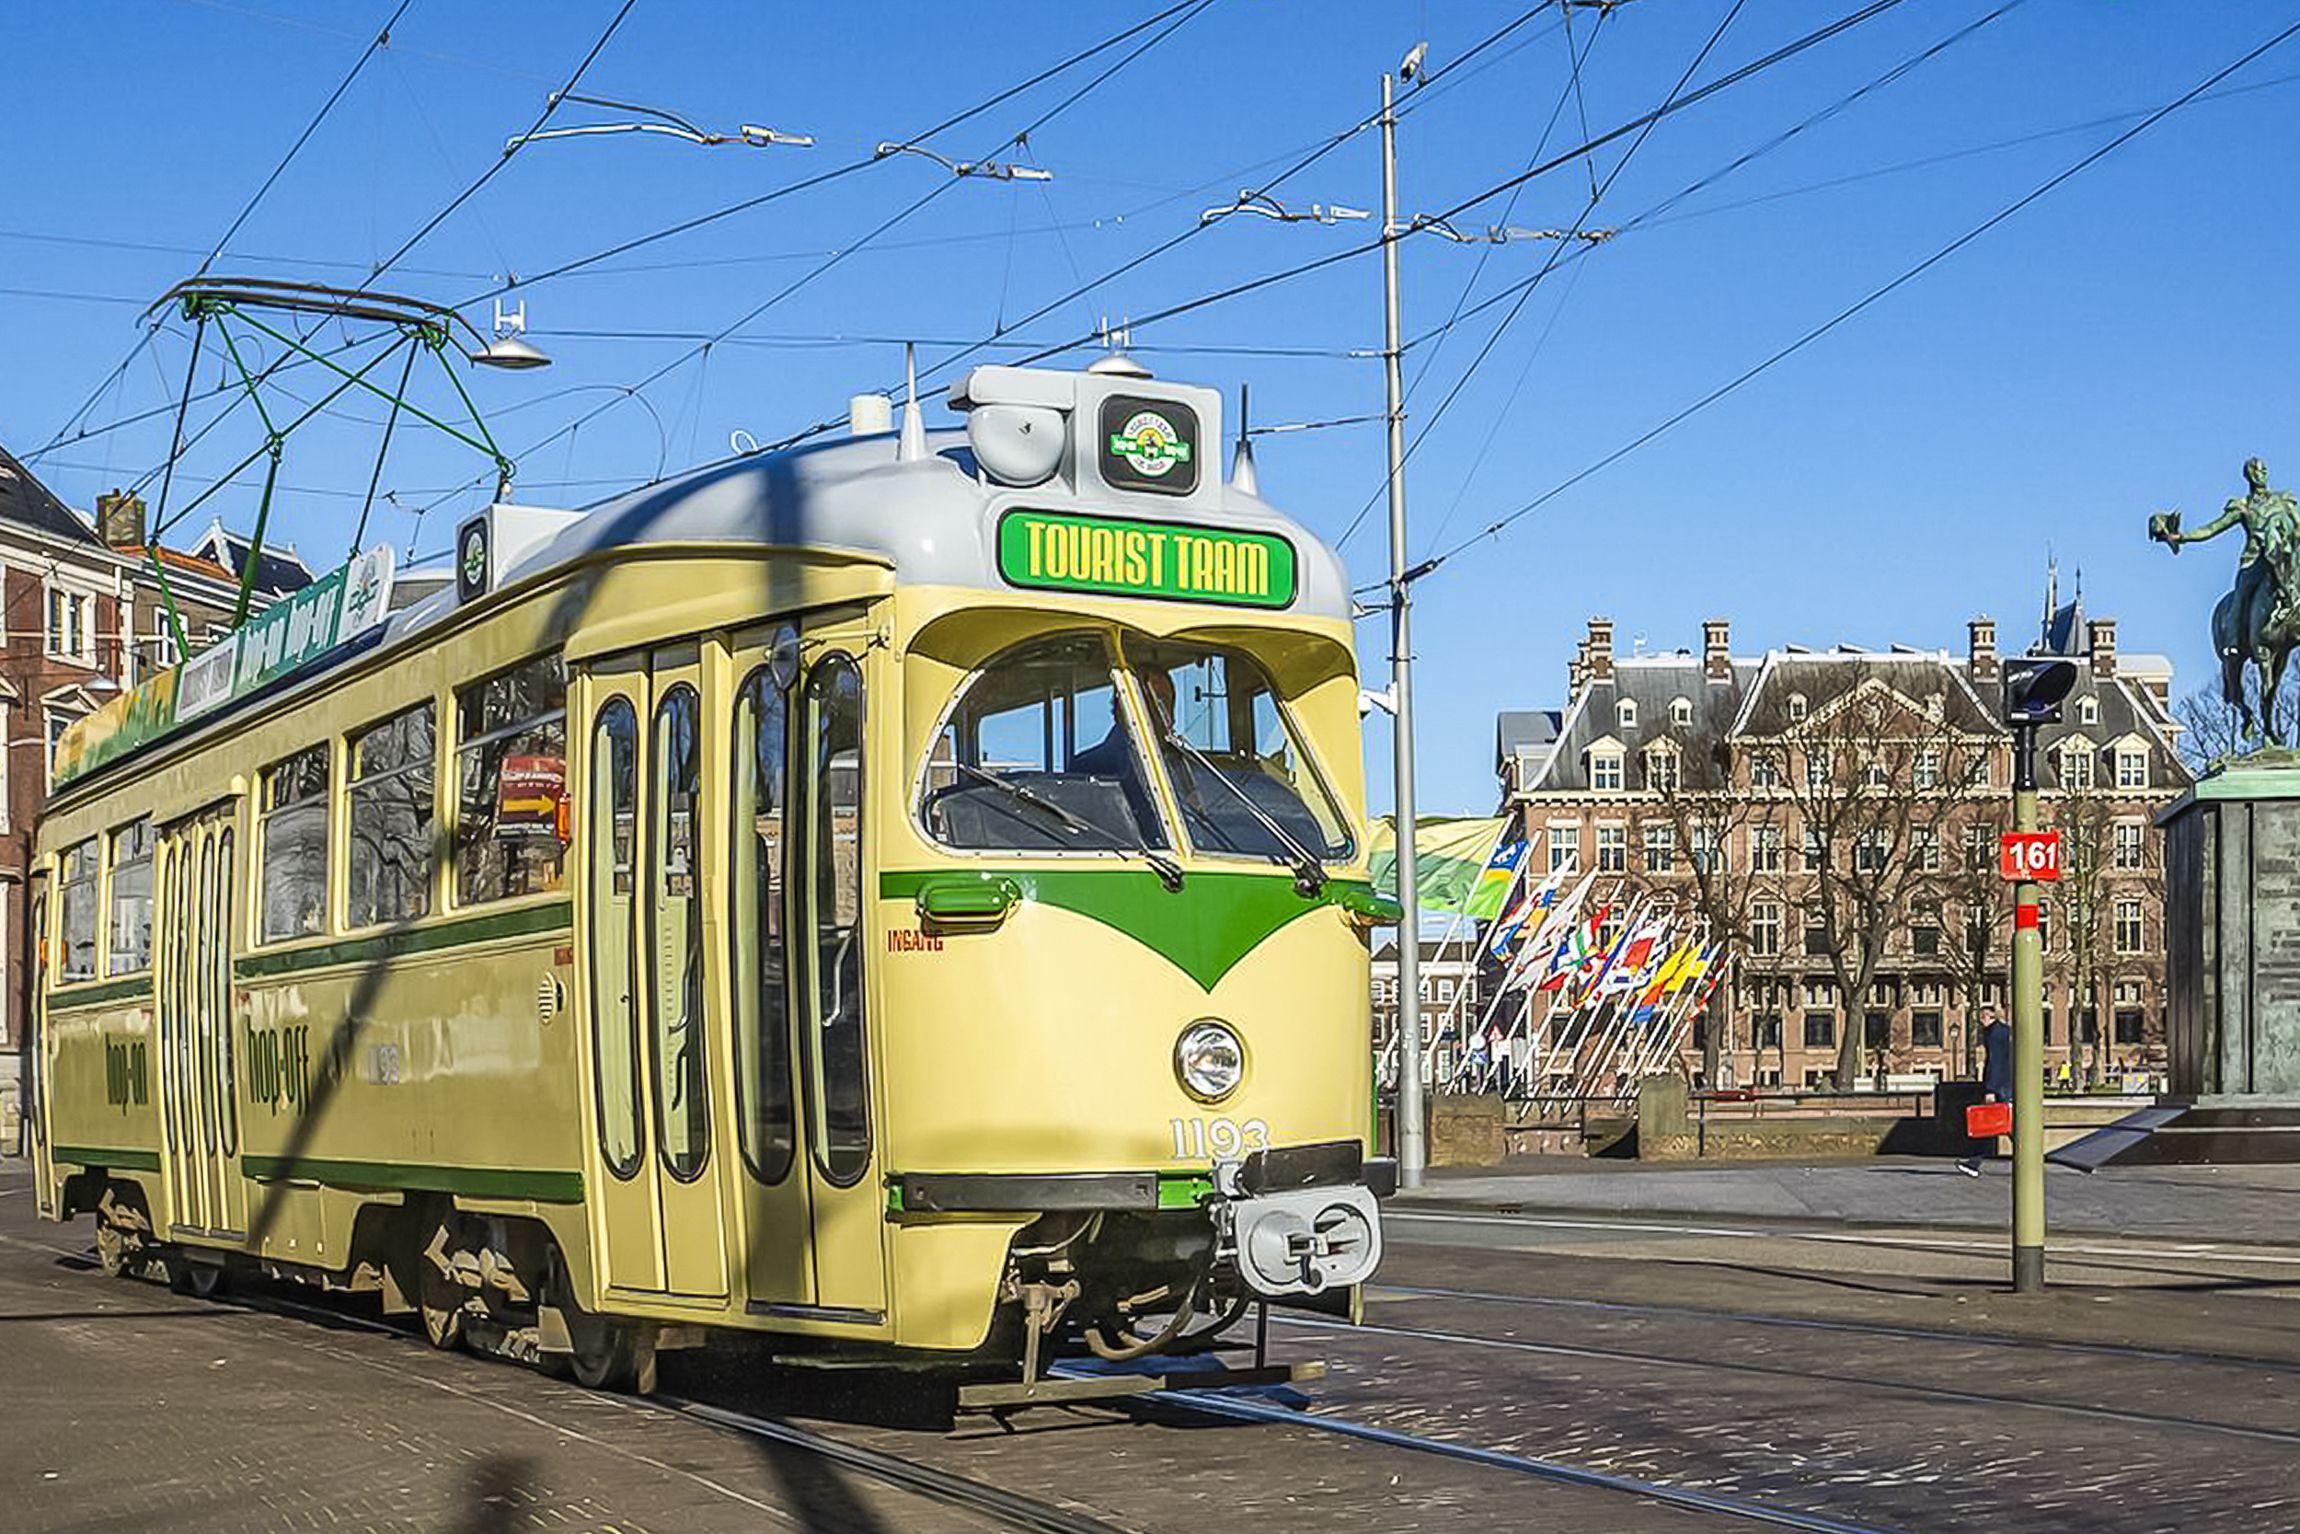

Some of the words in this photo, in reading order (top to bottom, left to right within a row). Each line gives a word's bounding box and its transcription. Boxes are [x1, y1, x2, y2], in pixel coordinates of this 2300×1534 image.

[1025, 521, 1167, 587] TOURIST
[1174, 534, 1269, 596] TRAM
[2008, 841, 2057, 870] 161
[887, 929, 944, 952] INGANG
[245, 1015, 310, 1117] hop-off
[1170, 1118, 1269, 1159] 1193
